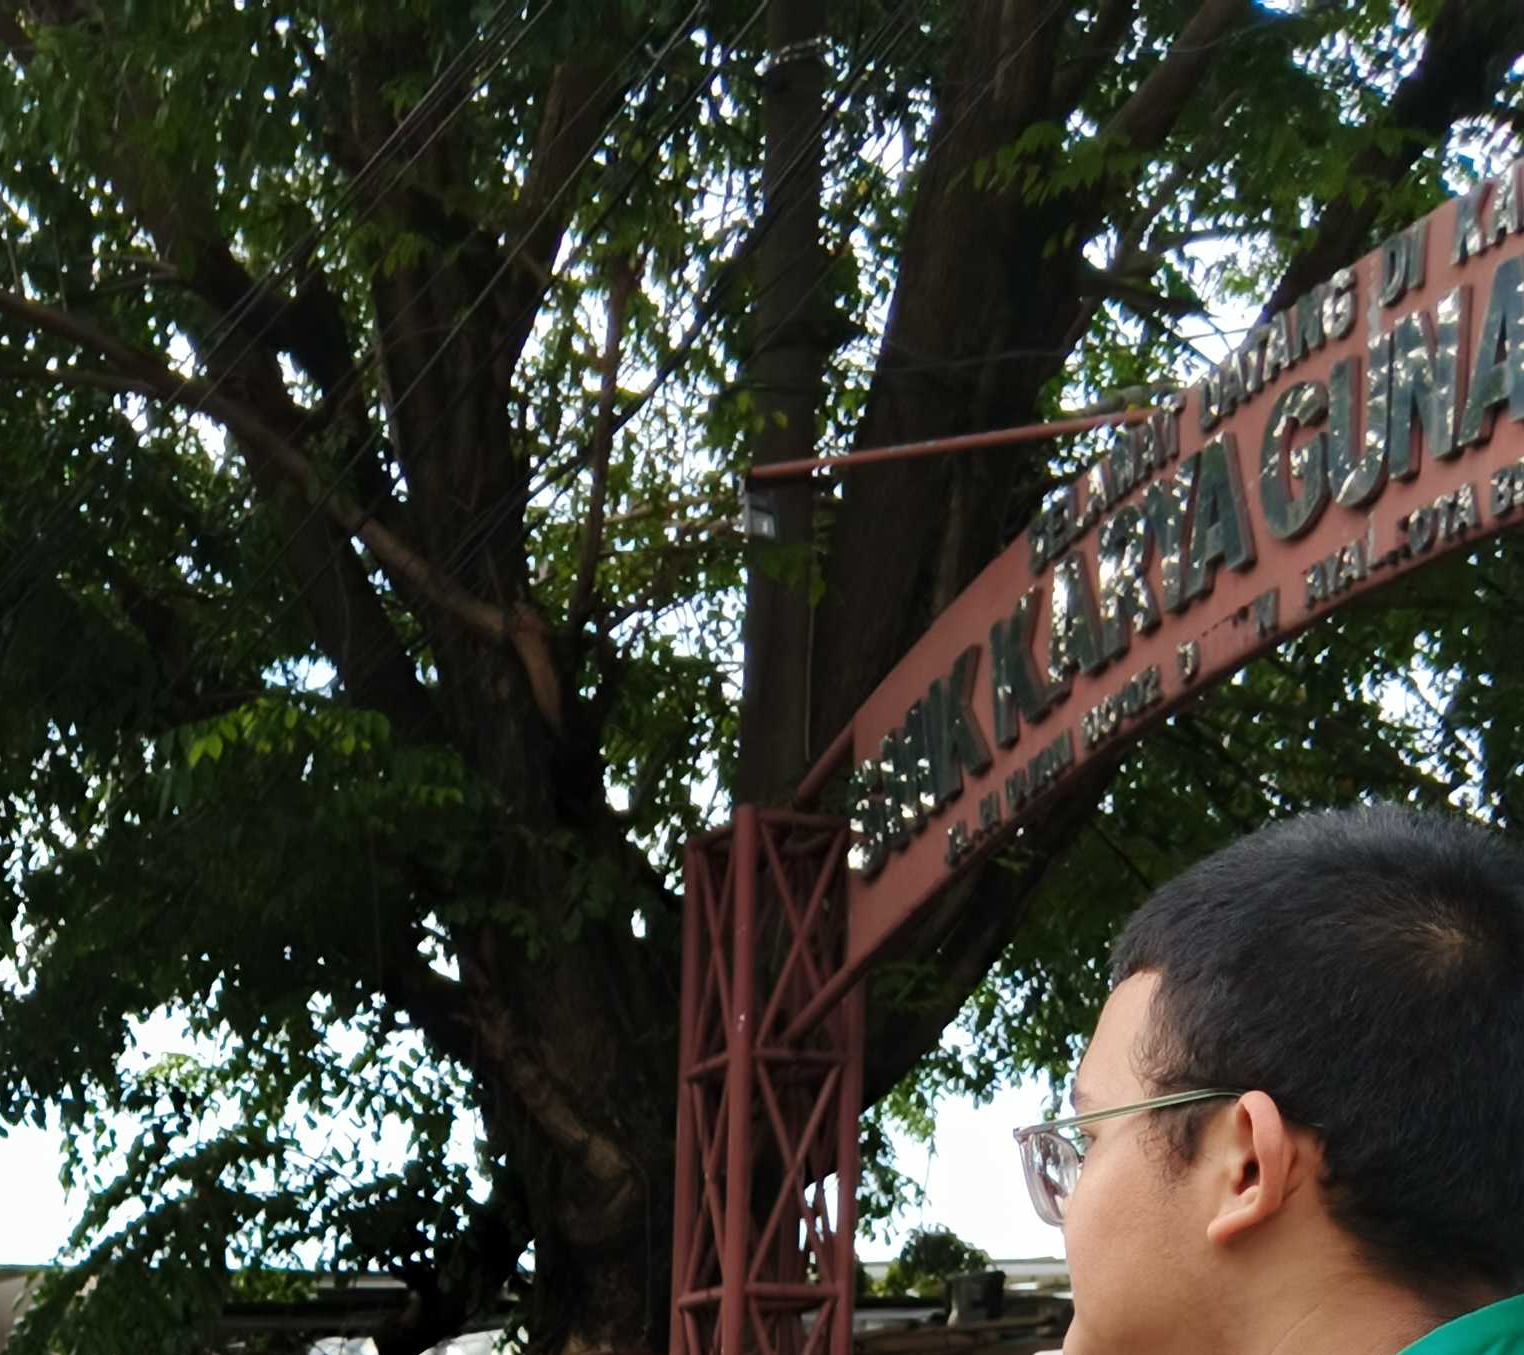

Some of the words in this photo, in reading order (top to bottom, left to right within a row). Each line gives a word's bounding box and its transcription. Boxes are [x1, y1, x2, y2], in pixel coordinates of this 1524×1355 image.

[988, 430, 1258, 752] KARYA
[1259, 254, 1524, 542] GUNA
[1198, 267, 1357, 433] DATANG
[1378, 218, 1430, 307] DI
